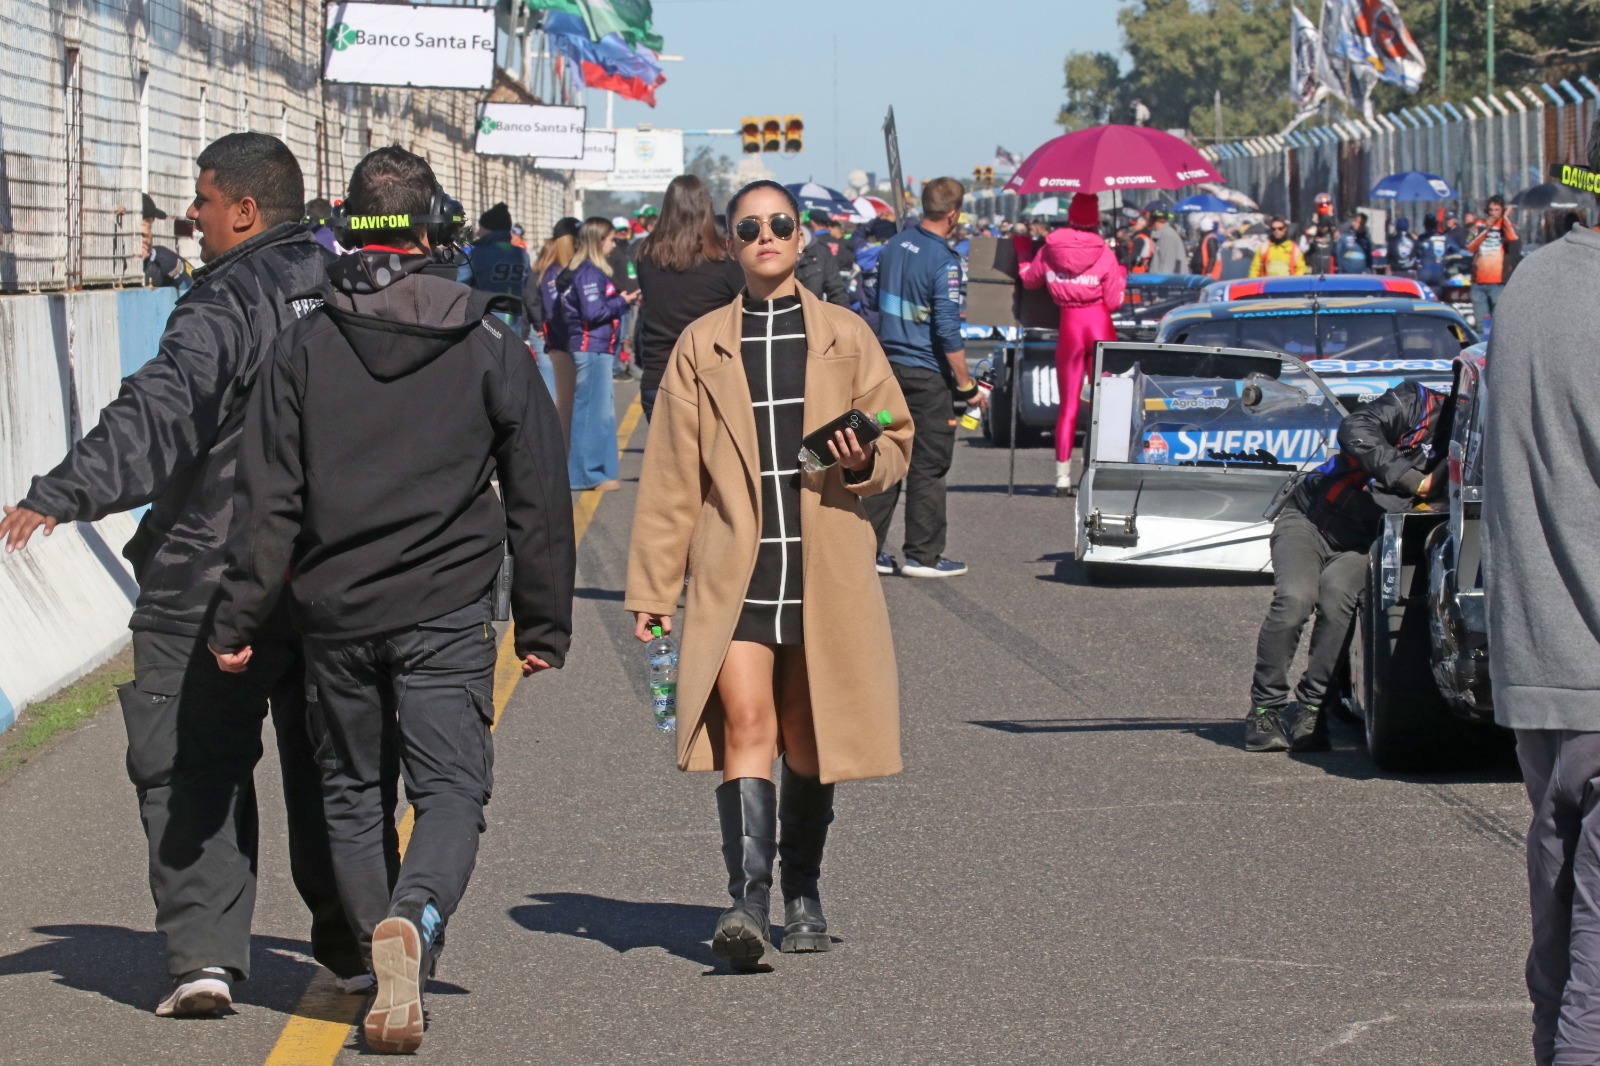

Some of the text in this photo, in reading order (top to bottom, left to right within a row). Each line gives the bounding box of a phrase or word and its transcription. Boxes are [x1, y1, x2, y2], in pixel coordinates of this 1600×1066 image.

[356, 30, 492, 50] Banco Santa Fe
[496, 121, 583, 134] Banco Santa Fe
[583, 145, 602, 153] anta
[1048, 178, 1081, 187] OTOWIL
[1116, 175, 1156, 185] OTOWIL
[351, 214, 410, 230] DAVICOM
[490, 262, 526, 283] 99
[1055, 272, 1101, 286] OTOWIL
[1233, 309, 1313, 318] FACUNDO
[1171, 398, 1229, 409] AgroSpray
[1174, 428, 1338, 460] SHERWIN
